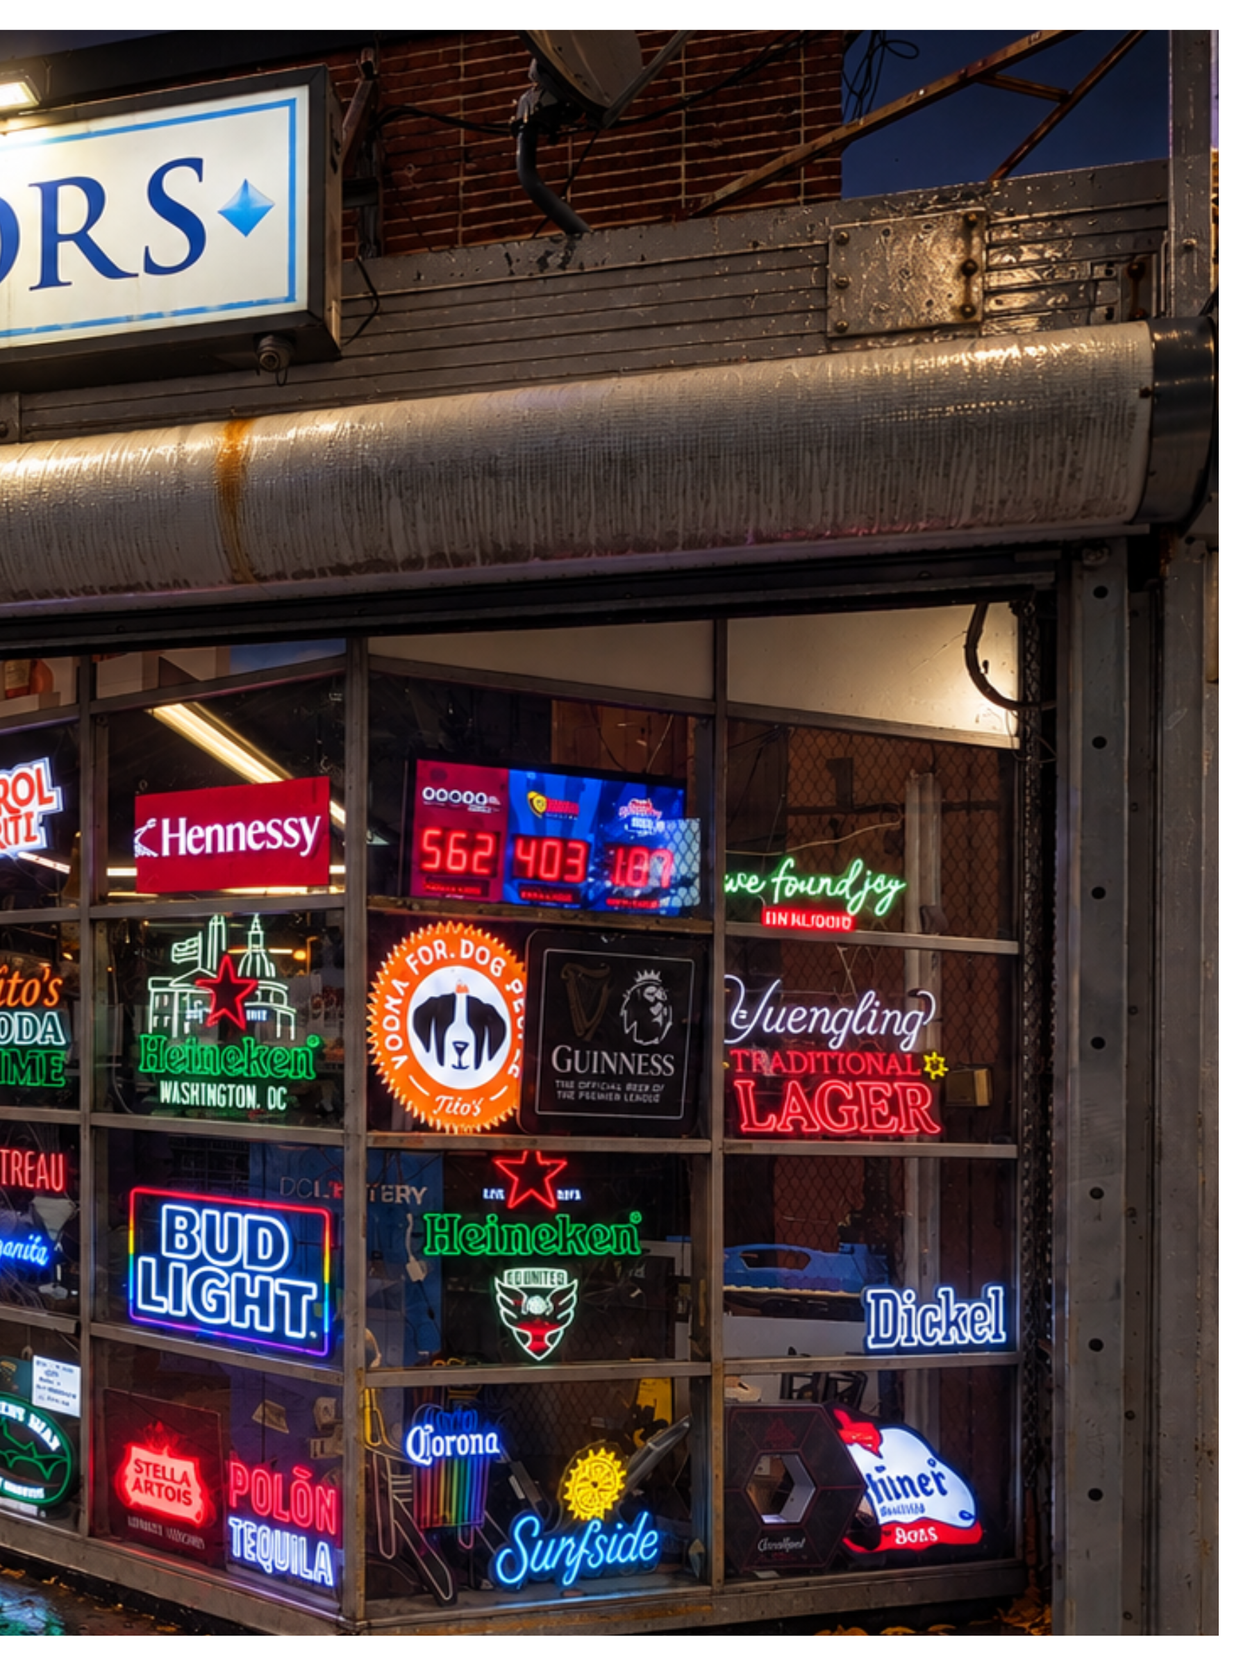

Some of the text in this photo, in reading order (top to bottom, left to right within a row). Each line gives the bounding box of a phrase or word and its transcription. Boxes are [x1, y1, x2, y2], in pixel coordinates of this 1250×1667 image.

[161, 815, 321, 857] Hennessy
[421, 829, 494, 875] 562
[514, 838, 587, 882] 403
[459, 938, 506, 977] DOG
[723, 974, 937, 1051] Yuengling
[139, 1034, 317, 1079] Heineken
[551, 1045, 675, 1077] GUINNESS
[730, 1049, 921, 1075] TRADITIONAL
[267, 1086, 288, 1110] DC
[733, 1080, 941, 1134] LAGER
[162, 1203, 290, 1272] BUD
[423, 1214, 642, 1256] Heineken
[866, 1287, 1007, 1349] Dickel
[131, 1477, 193, 1506] ARTOIS
[134, 1458, 191, 1488] STELLA
[229, 1516, 334, 1586] TEQUILA
[495, 1511, 659, 1586] Surfside
